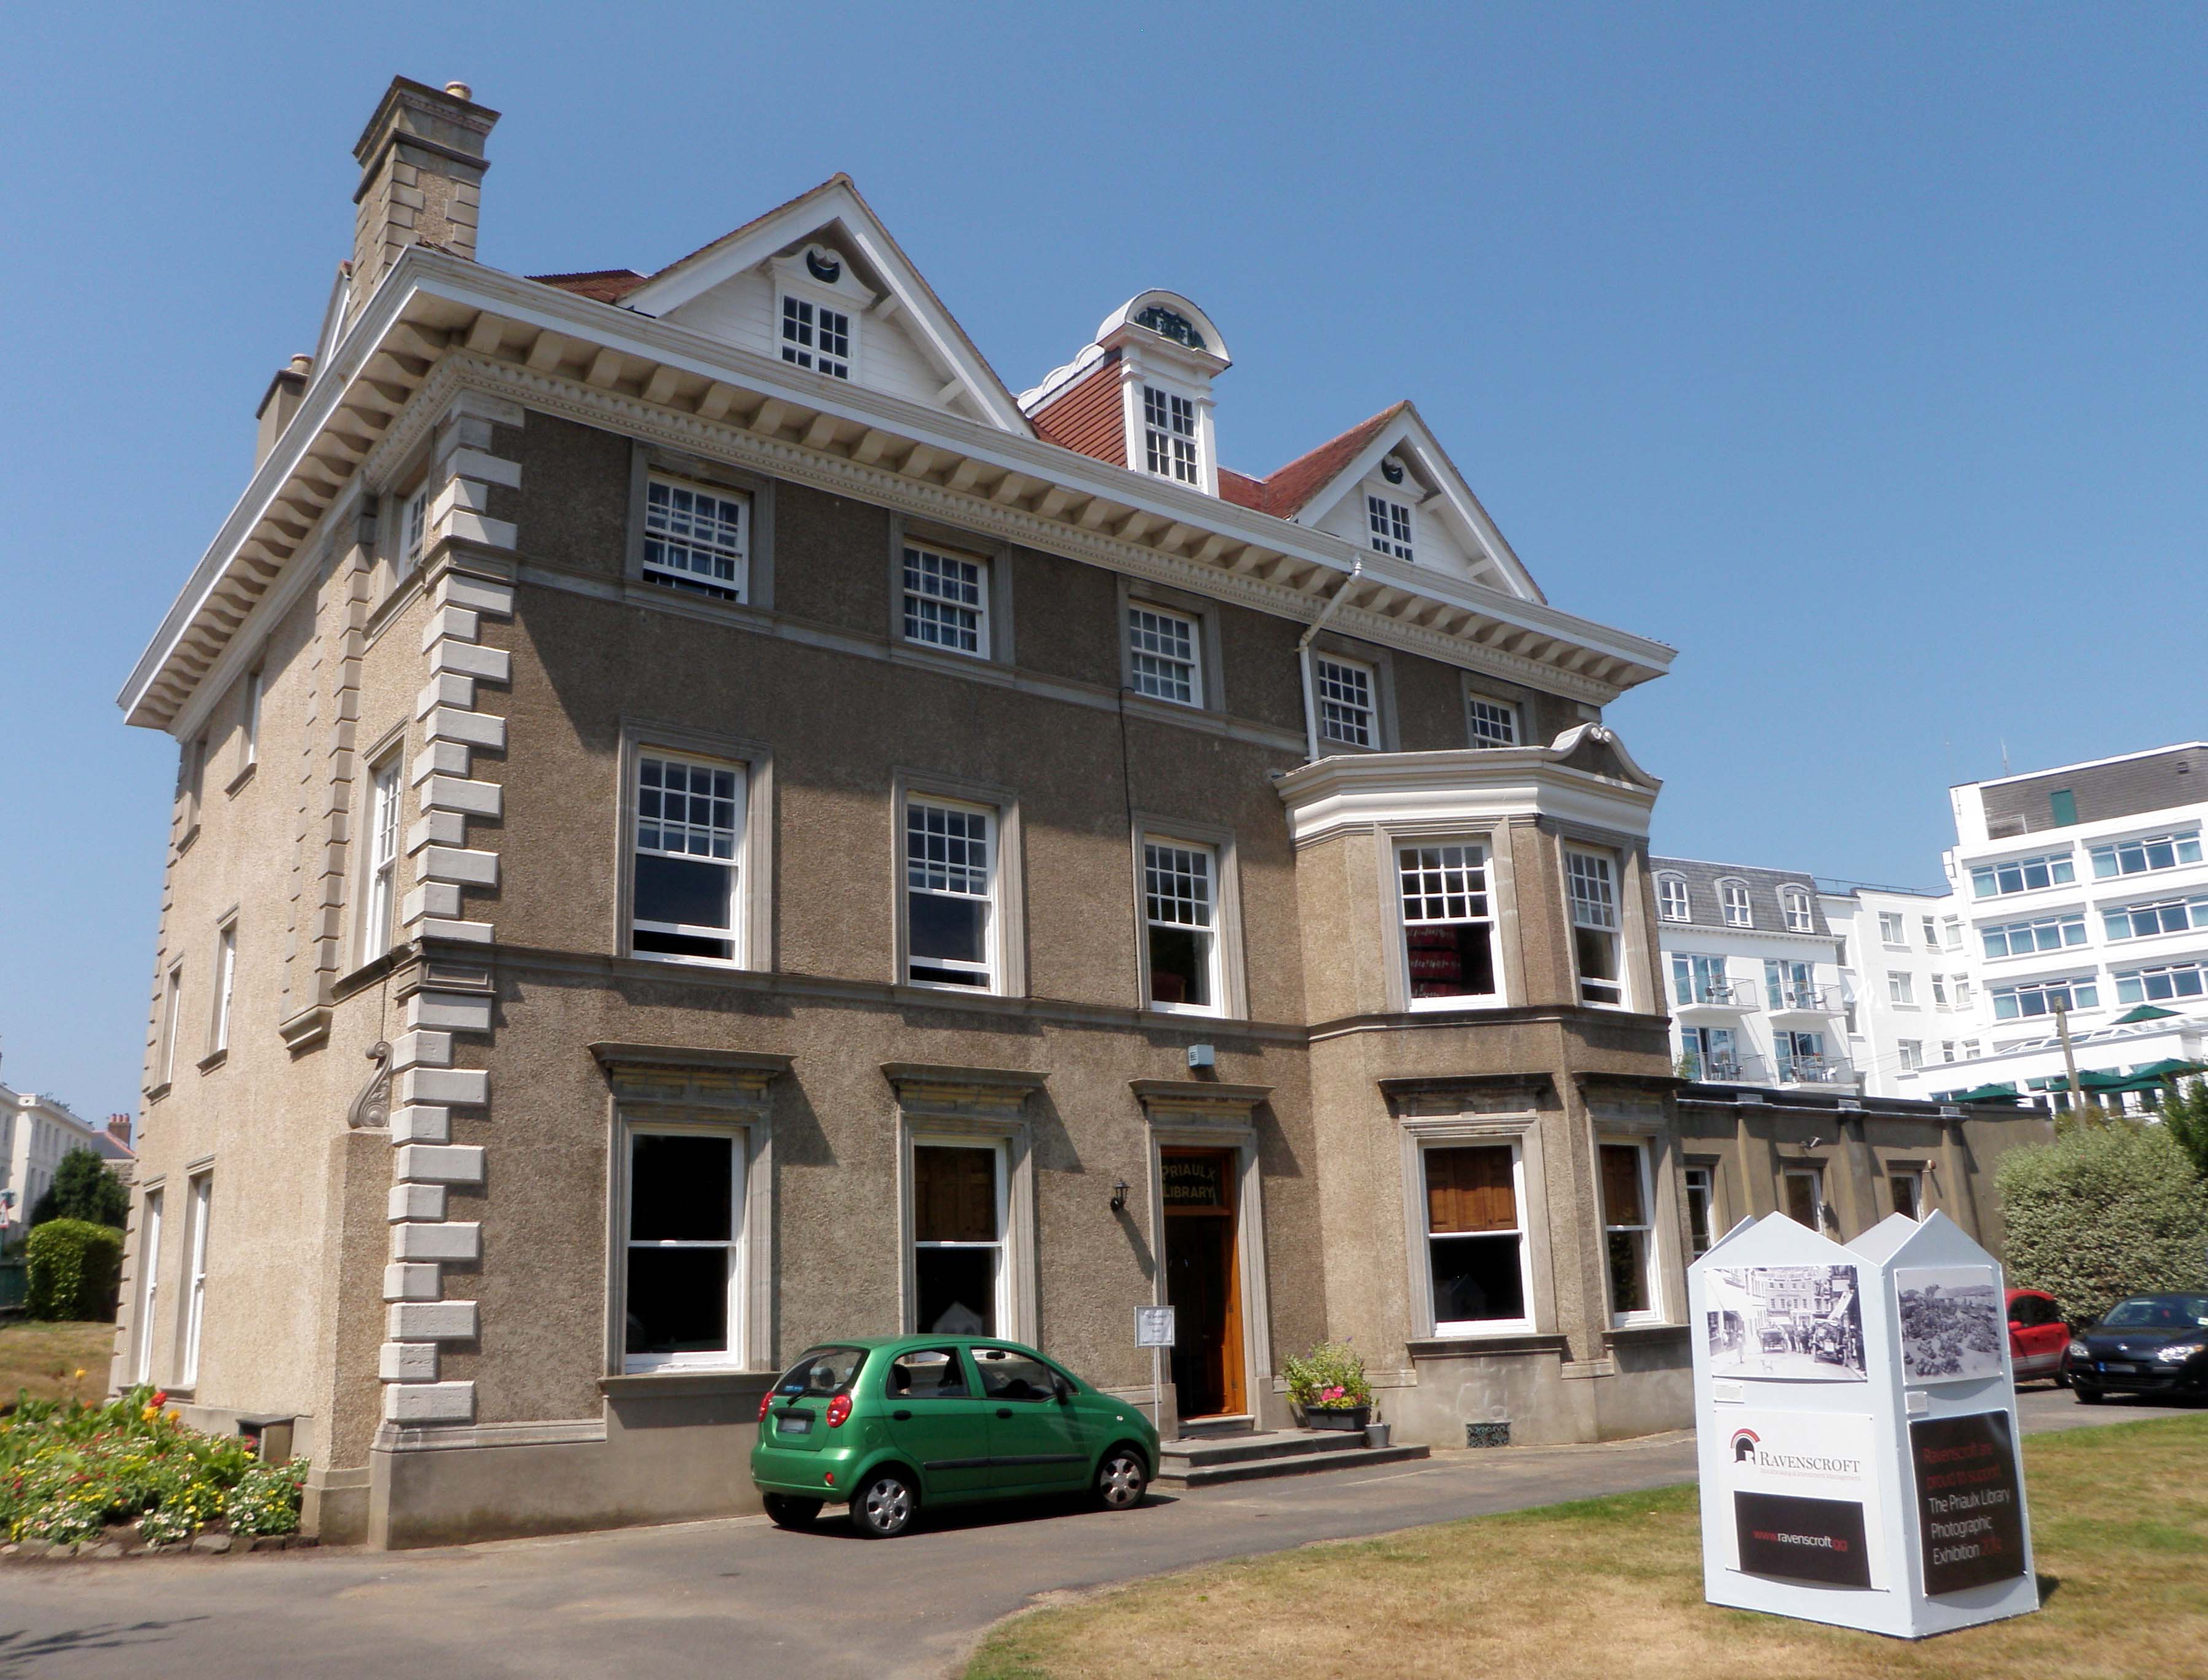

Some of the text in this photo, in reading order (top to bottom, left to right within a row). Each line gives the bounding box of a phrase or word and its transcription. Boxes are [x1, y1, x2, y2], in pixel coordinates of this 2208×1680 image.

[1162, 1164, 1216, 1180] PRIAULX
[1162, 1184, 1216, 1198] LIBRARY
[1928, 1488, 2011, 1514] The Priaulx Library
[1931, 1514, 1992, 1539] Photographic
[1933, 1544, 1980, 1565] Exhibition
